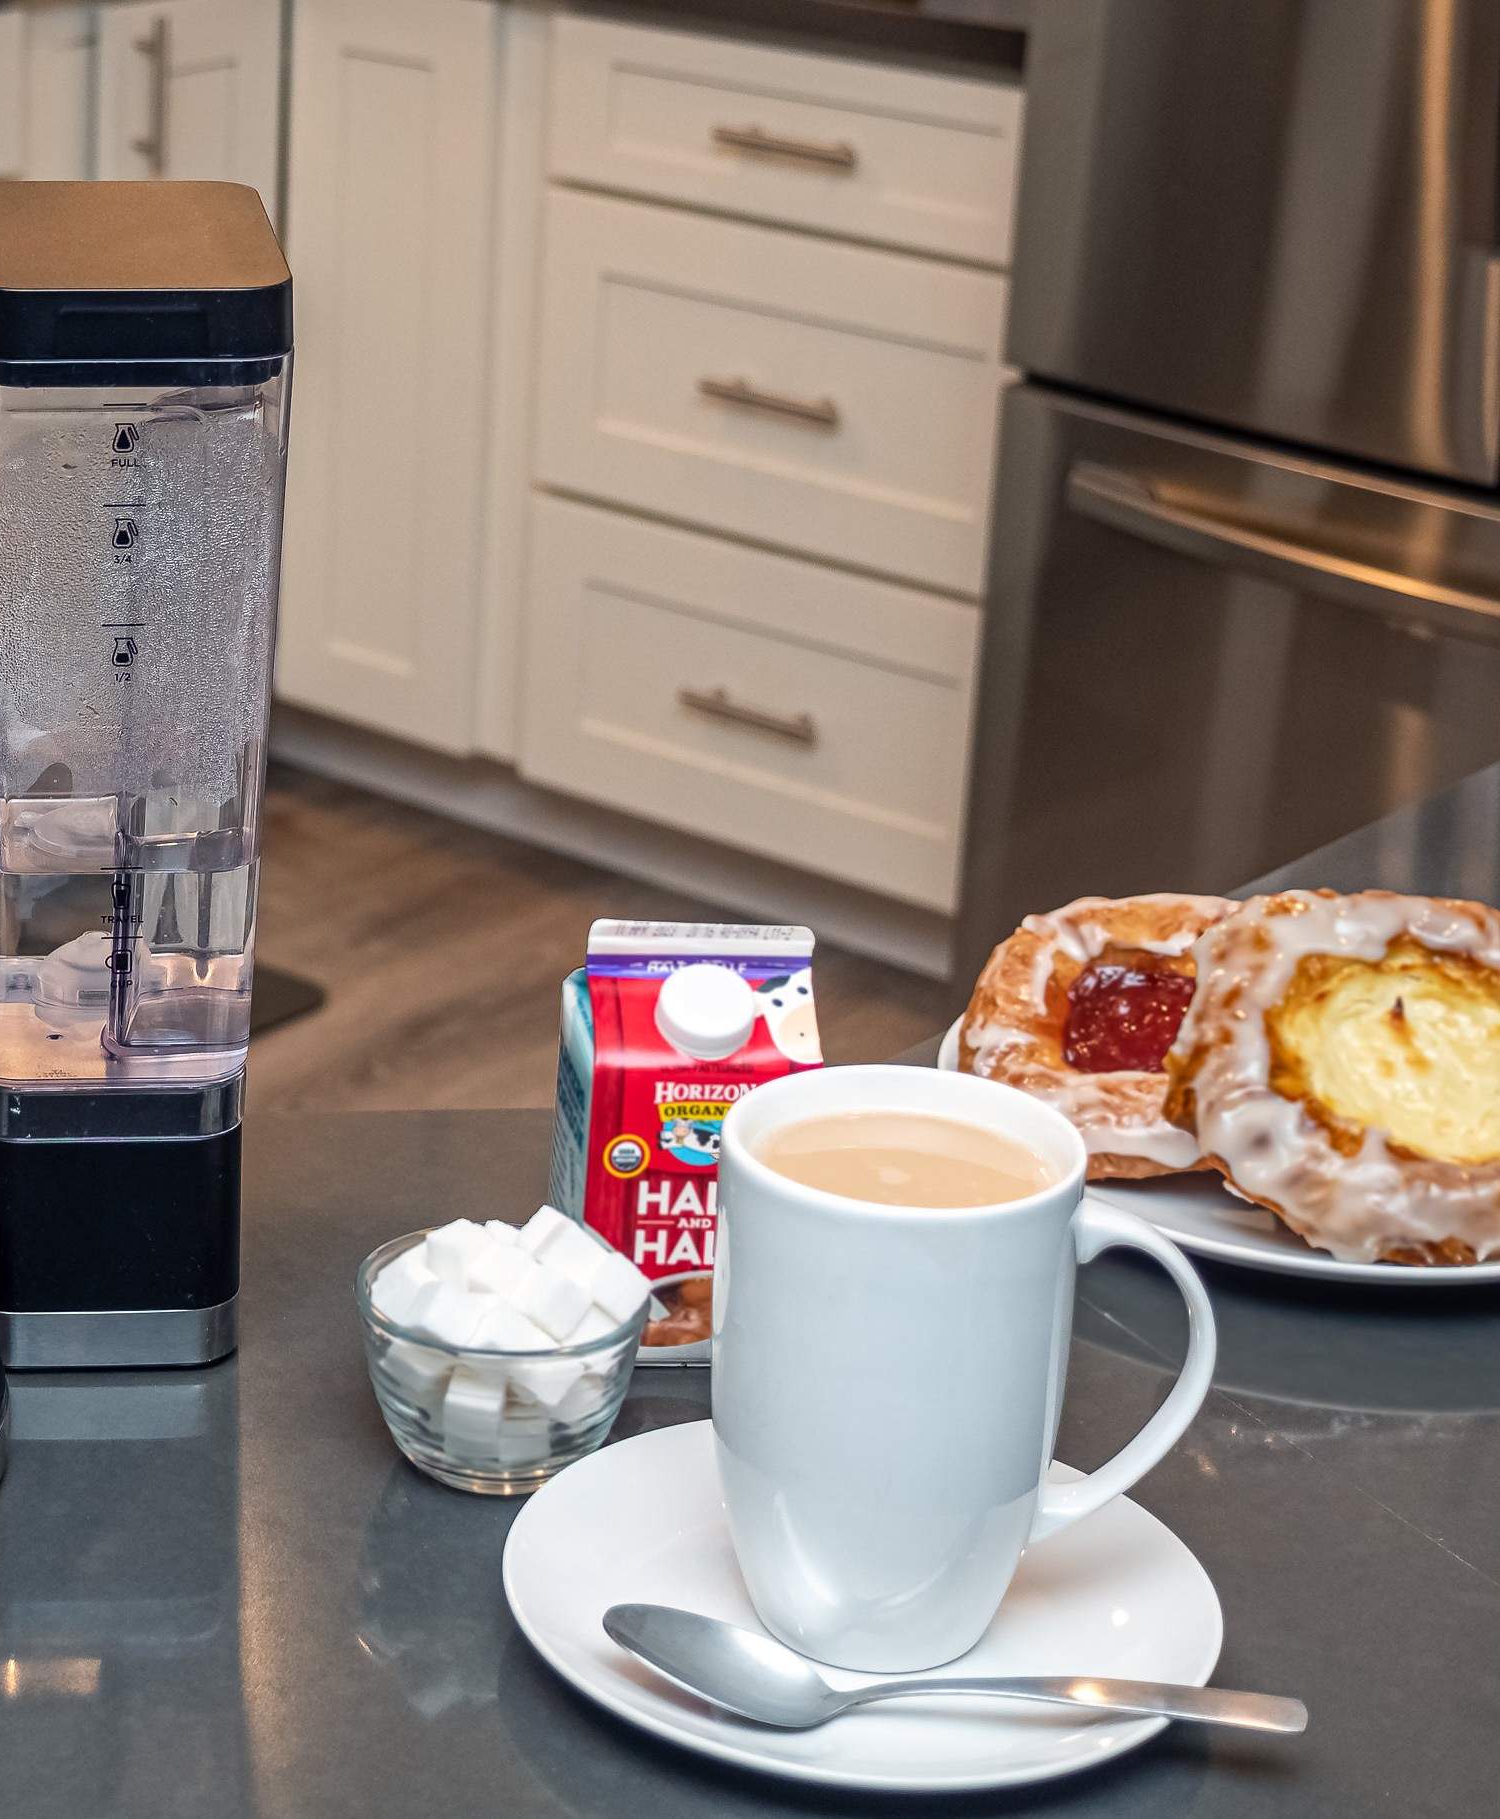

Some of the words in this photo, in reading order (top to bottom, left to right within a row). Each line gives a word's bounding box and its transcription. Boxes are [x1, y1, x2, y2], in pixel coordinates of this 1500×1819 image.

[112, 459, 140, 468] FULL
[114, 554, 132, 564] 3/4
[114, 673, 131, 682] 1/2
[100, 915, 144, 924] TRAVEL
[110, 980, 133, 988] CUP
[664, 1104, 729, 1117] ORGAN
[677, 1218, 712, 1228] AND
